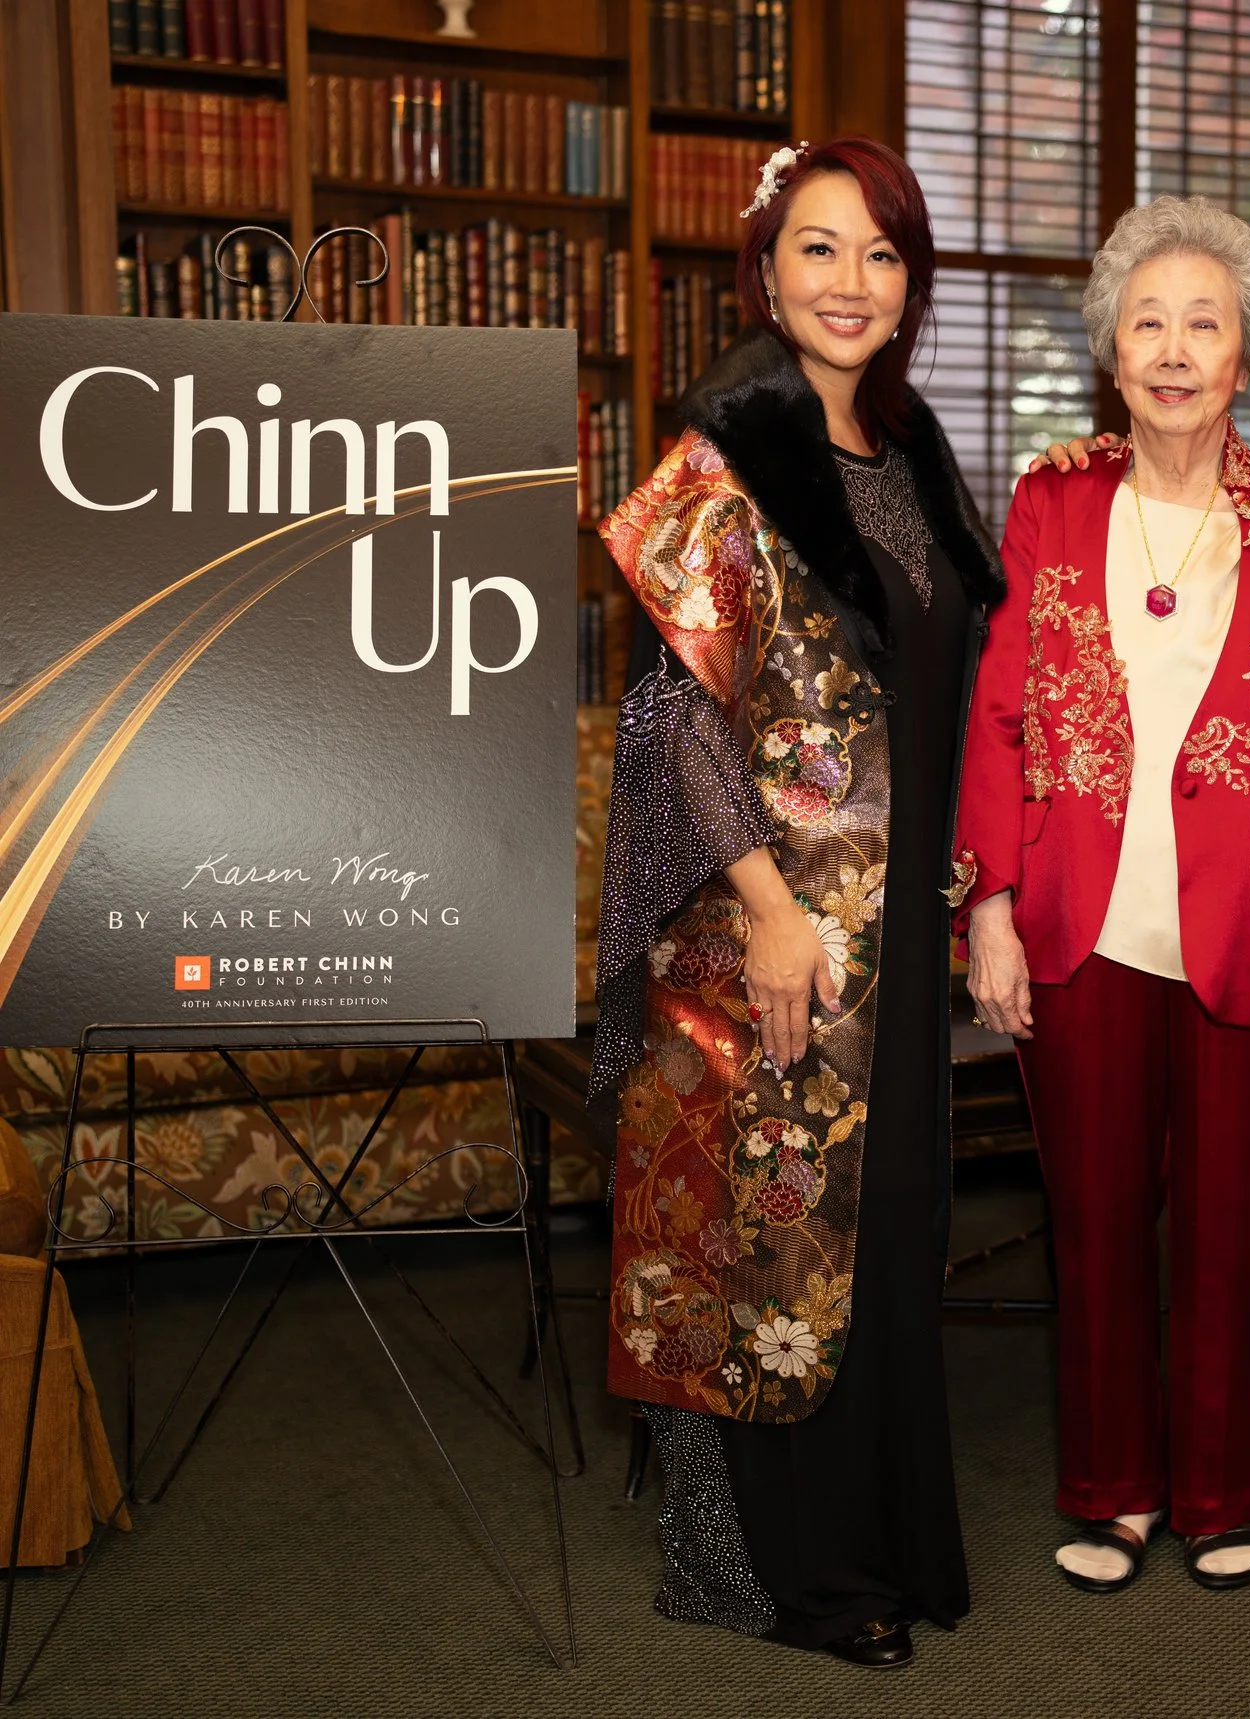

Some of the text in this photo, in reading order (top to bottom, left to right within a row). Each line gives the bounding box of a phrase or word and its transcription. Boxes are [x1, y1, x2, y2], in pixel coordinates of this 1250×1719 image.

[40, 366, 450, 516] Chinn
[351, 531, 538, 715] Up
[182, 852, 429, 901] Karen Wong
[110, 908, 458, 929] BY KAREN WONG
[219, 955, 393, 973] ROBERT CHINN
[219, 974, 392, 987] FOUNDATION
[181, 997, 389, 1009] 40TH ANNIVERSARY FIRST EDITION
